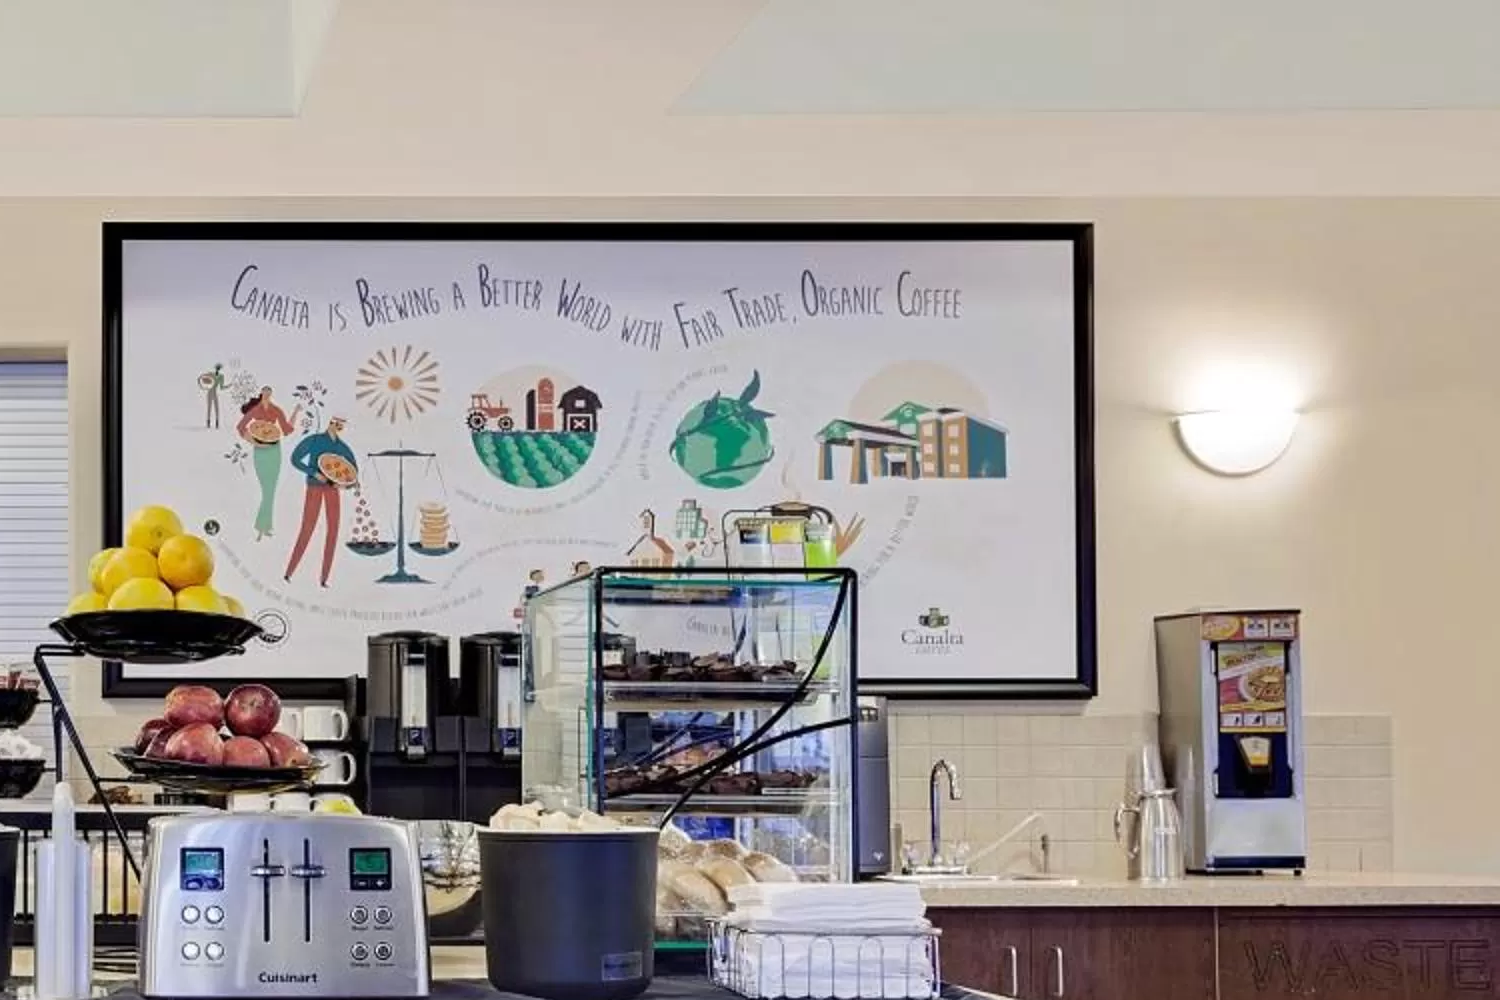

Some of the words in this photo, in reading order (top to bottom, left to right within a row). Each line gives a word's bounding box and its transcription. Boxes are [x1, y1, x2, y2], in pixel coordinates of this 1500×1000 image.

[231, 264, 310, 329] CANALTA
[328, 302, 347, 332] IS
[355, 277, 441, 329] BREWING
[477, 263, 543, 312] BETTER
[557, 277, 612, 333] WORLD
[620, 315, 664, 351] WITH
[673, 302, 725, 350] FAIR
[800, 269, 884, 317] ORGANIC
[897, 270, 963, 319] COFFEE
[901, 629, 964, 645] Canalta
[258, 971, 317, 983] Cuisinart
[1243, 938, 1493, 991] WASTE
